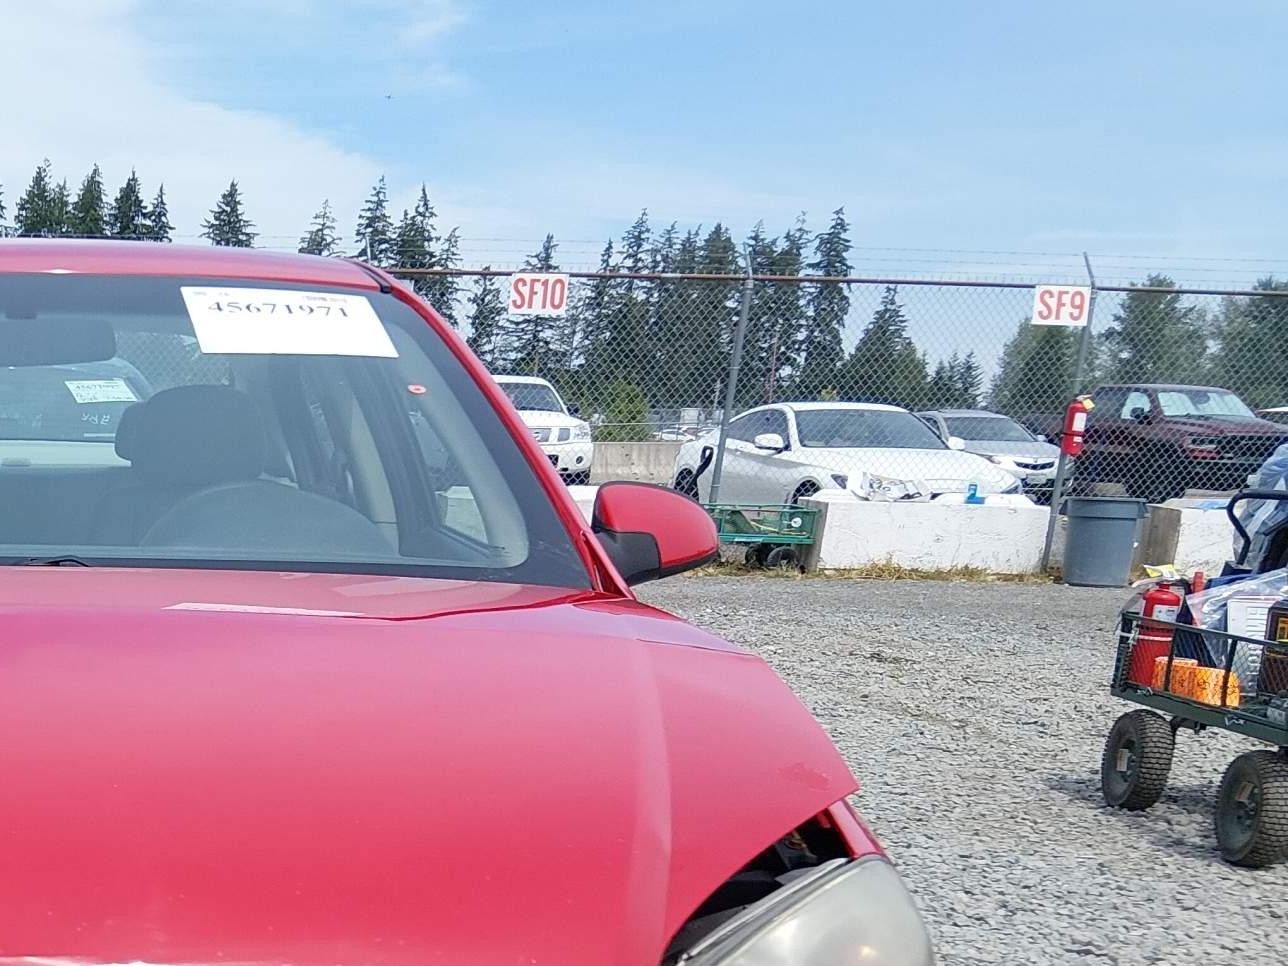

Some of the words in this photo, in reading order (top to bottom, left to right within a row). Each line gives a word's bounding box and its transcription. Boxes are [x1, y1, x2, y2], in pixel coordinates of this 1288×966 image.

[208, 301, 350, 319] 45671971
[511, 278, 566, 310] SF10
[1038, 288, 1086, 322] SF9
